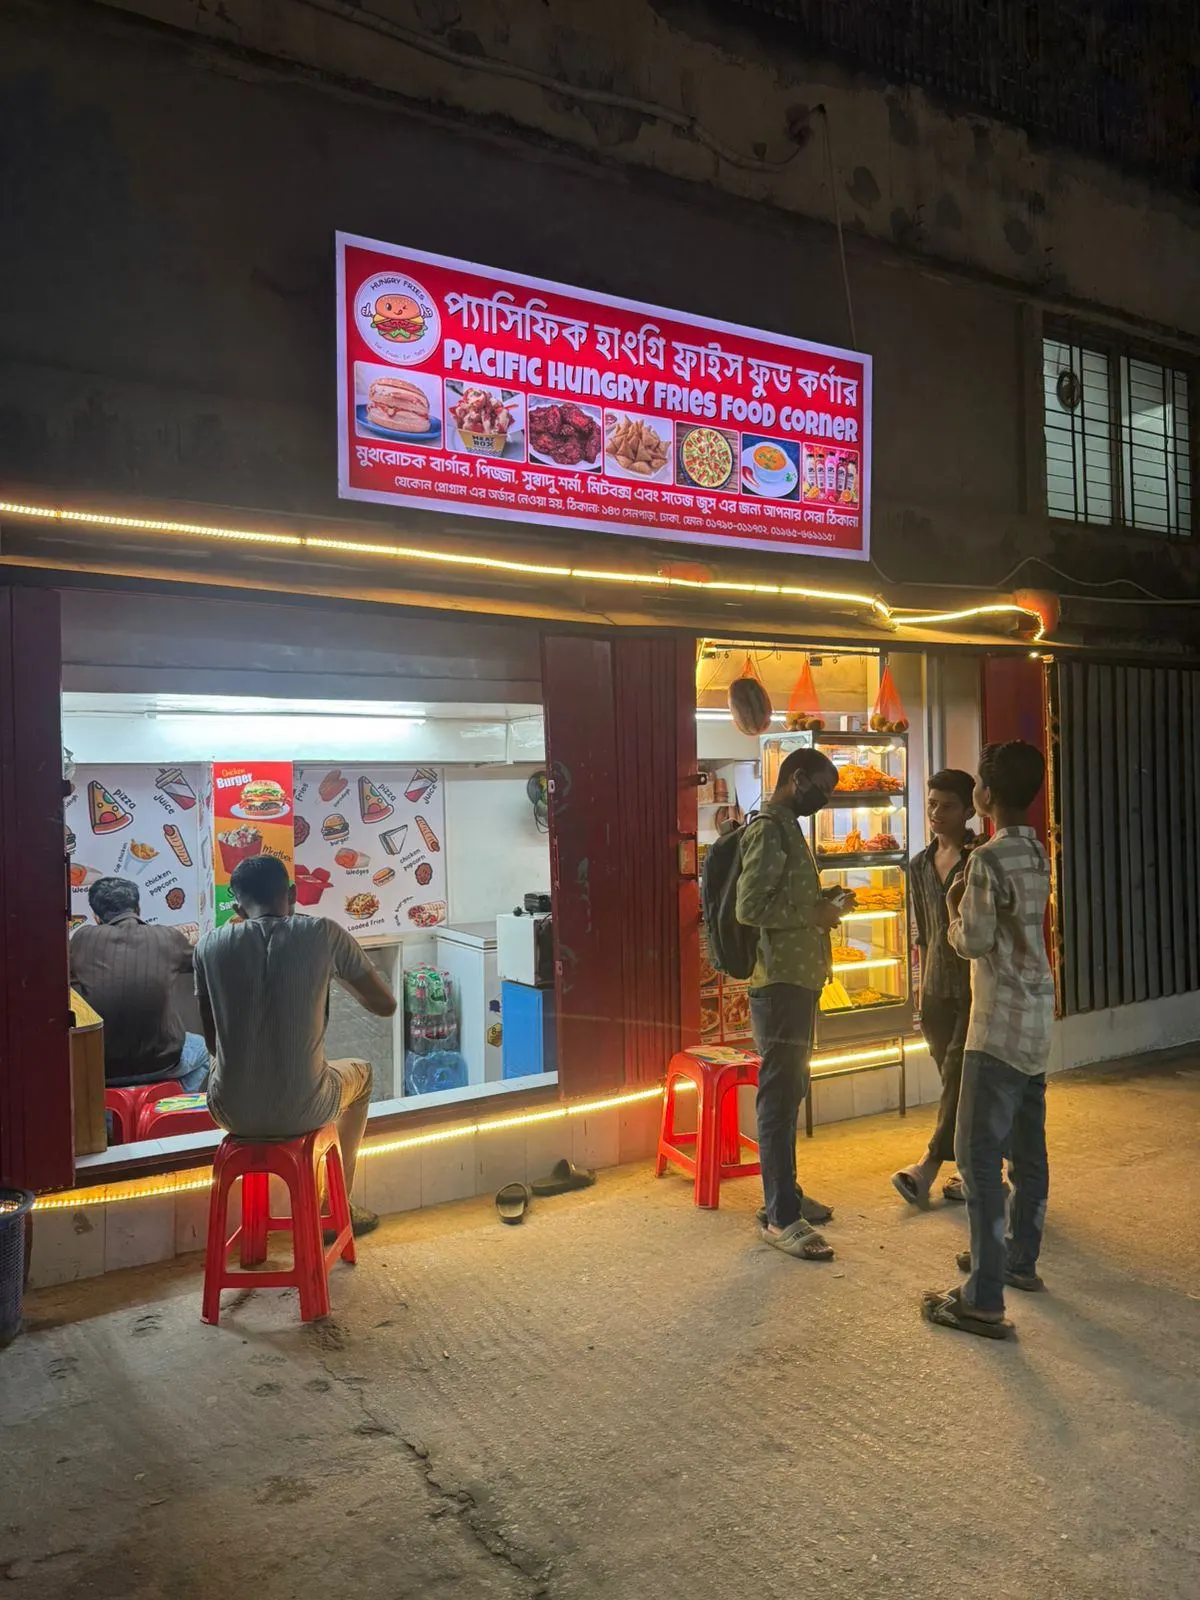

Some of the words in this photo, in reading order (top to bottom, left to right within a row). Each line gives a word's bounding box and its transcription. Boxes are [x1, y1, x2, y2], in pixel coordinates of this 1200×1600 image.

[370, 277, 401, 291] HUNGRY
[403, 281, 425, 301] FRIES
[444, 291, 589, 351] প্যাসিফিক
[594, 323, 666, 370] হাংগ্রি
[671, 342, 744, 384] ফ্রাইস
[747, 357, 793, 398] ফুড
[444, 338, 543, 387] PACIFIC
[548, 360, 650, 406] HUNGRY
[653, 381, 717, 419] FRIES
[721, 394, 776, 428] FOOD
[779, 405, 858, 443] CORNER
[355, 445, 426, 468] মুখরোচক
[429, 454, 473, 478] বার্গার,
[634, 488, 659, 502] এবং
[661, 490, 695, 507] সতেজ
[695, 496, 716, 514] জুস
[719, 499, 737, 513] এর
[739, 501, 761, 516] জন্য
[763, 504, 801, 521] আপনার
[803, 510, 824, 524] সেরা
[826, 508, 858, 528] ঠিকানা
[395, 475, 432, 490] যেকোন
[470, 486, 486, 499] এর
[488, 487, 515, 503] অর্ডার
[216, 772, 252, 789] Burger
[113, 788, 136, 810] pizza
[378, 783, 397, 802] pizza
[144, 869, 172, 888] chicken
[149, 876, 178, 896] popcorn
